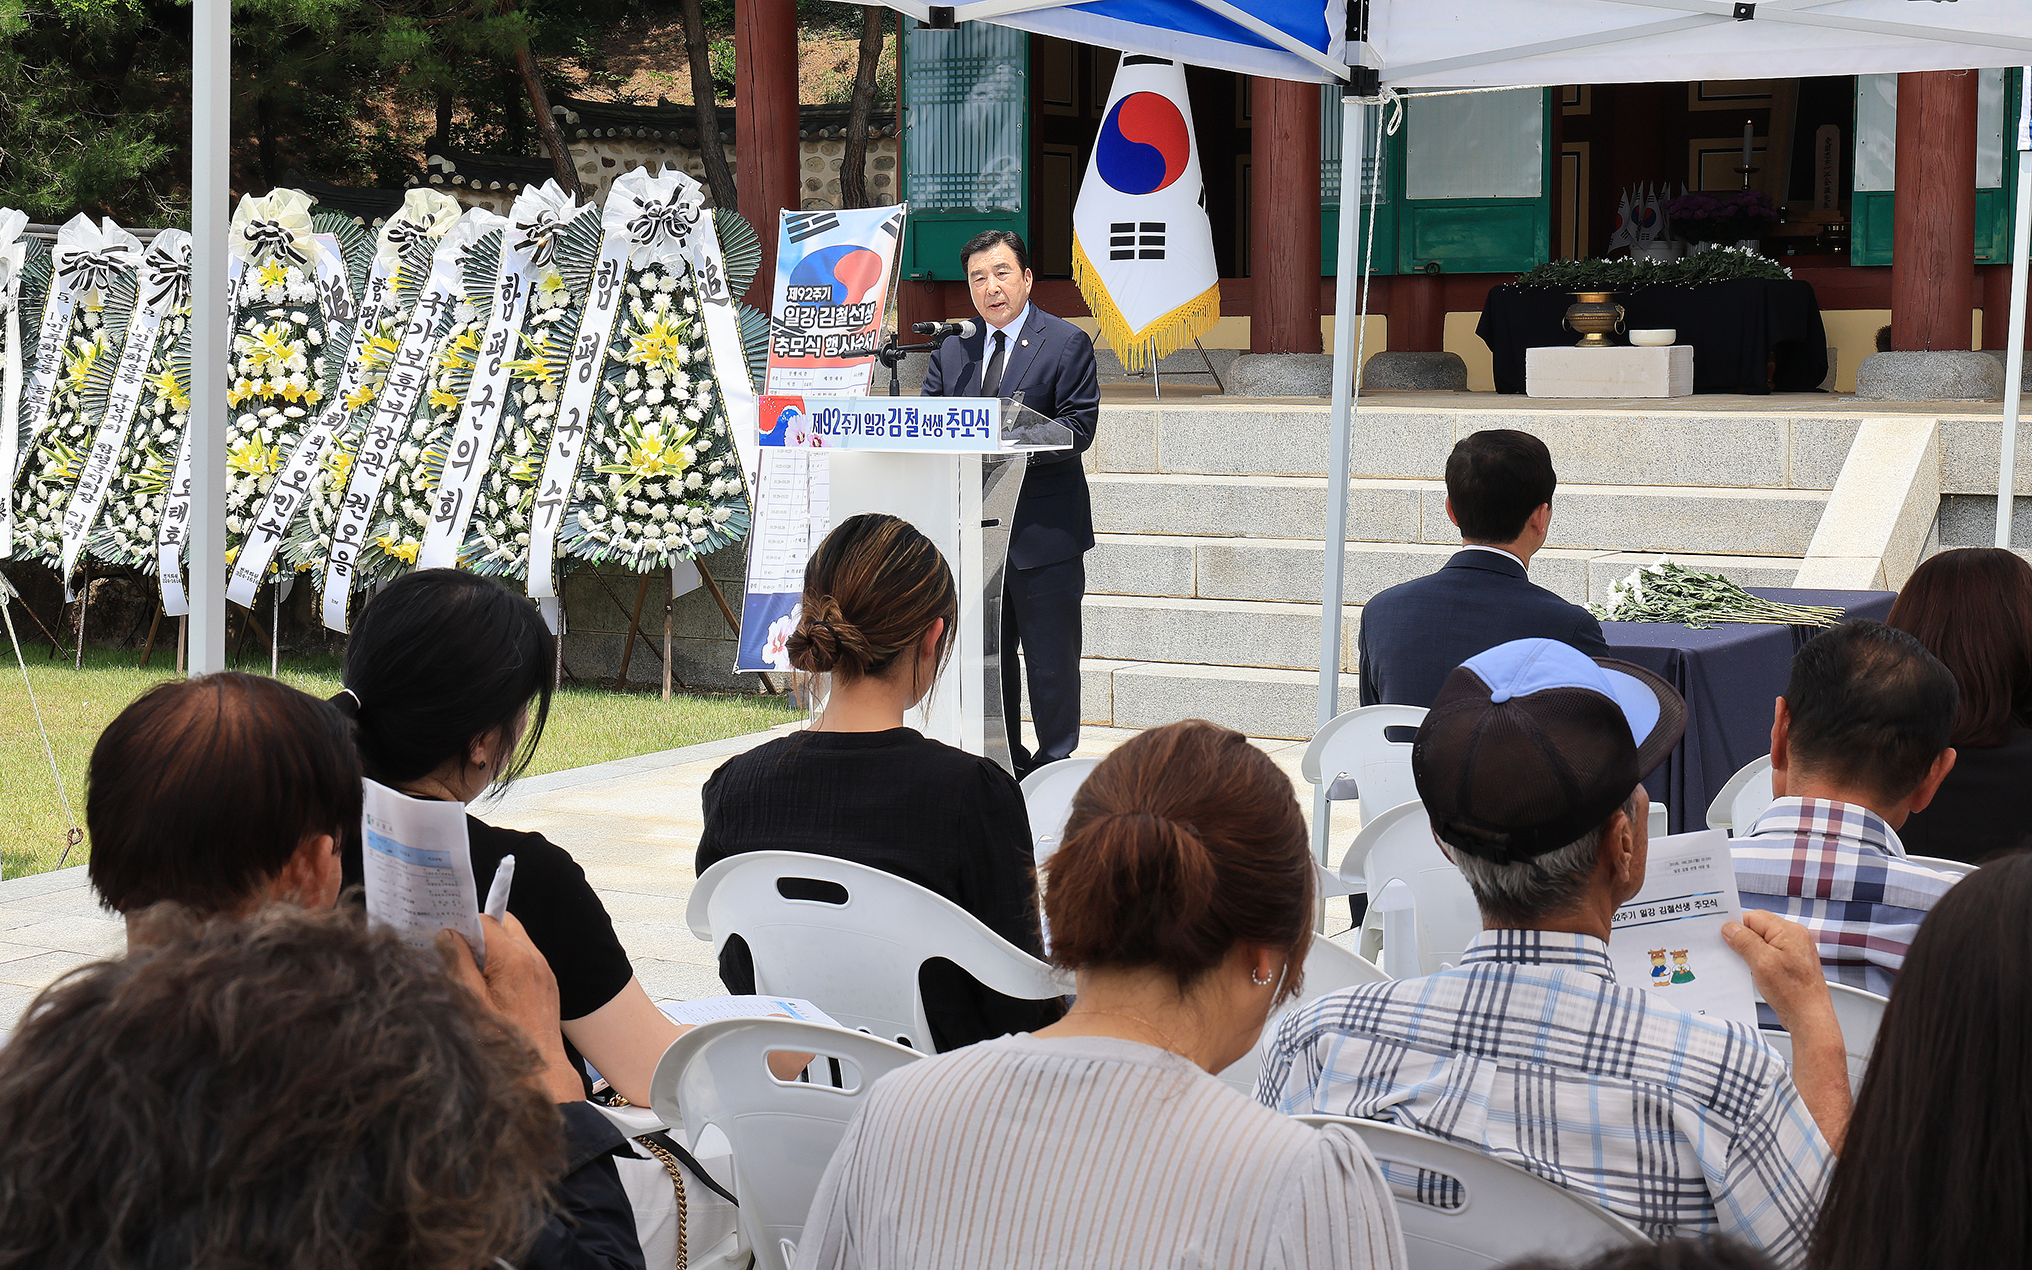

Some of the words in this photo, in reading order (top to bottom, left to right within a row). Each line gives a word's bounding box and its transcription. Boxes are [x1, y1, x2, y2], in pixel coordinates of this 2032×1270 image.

[784, 306, 817, 328] 일강
[818, 302, 876, 328] 김철선생
[787, 286, 832, 302] 제92주기
[774, 335, 822, 358] 추모식
[359, 291, 442, 478] 국가보훈부장관
[435, 273, 521, 536] 함평군의회
[537, 258, 620, 529] 함평군수
[812, 407, 862, 435] 제92주기
[864, 412, 886, 436] 일강
[921, 414, 944, 437] 선생
[946, 407, 990, 438] 추모식
[256, 469, 308, 543] 오민수
[330, 492, 370, 577] 권오을
[1639, 908, 1656, 918] 일강
[1694, 899, 1718, 909] 추모식
